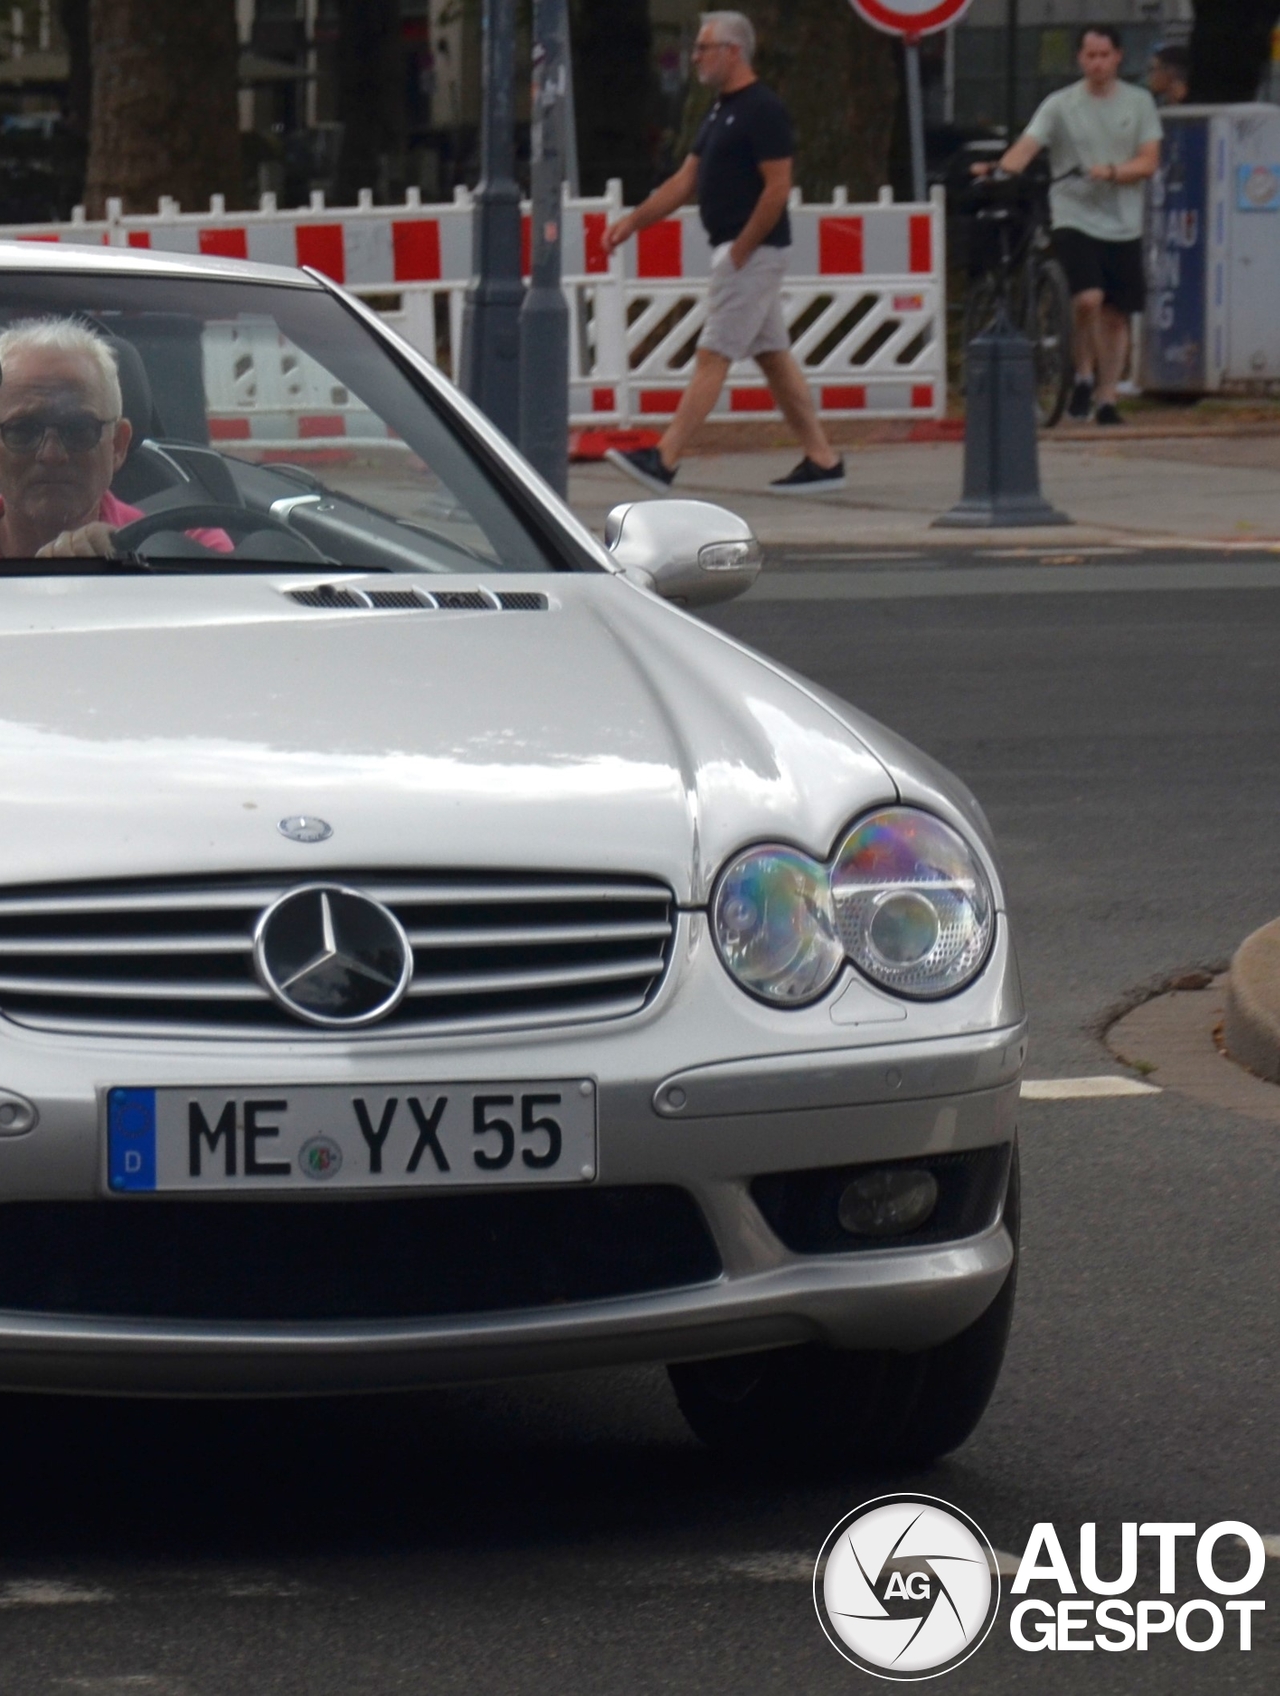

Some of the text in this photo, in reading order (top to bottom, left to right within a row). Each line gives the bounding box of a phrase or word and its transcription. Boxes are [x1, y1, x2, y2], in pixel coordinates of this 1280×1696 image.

[189, 1099, 291, 1177] ME
[352, 1096, 451, 1173] YX
[473, 1094, 562, 1171] 55
[124, 1151, 142, 1173] D
